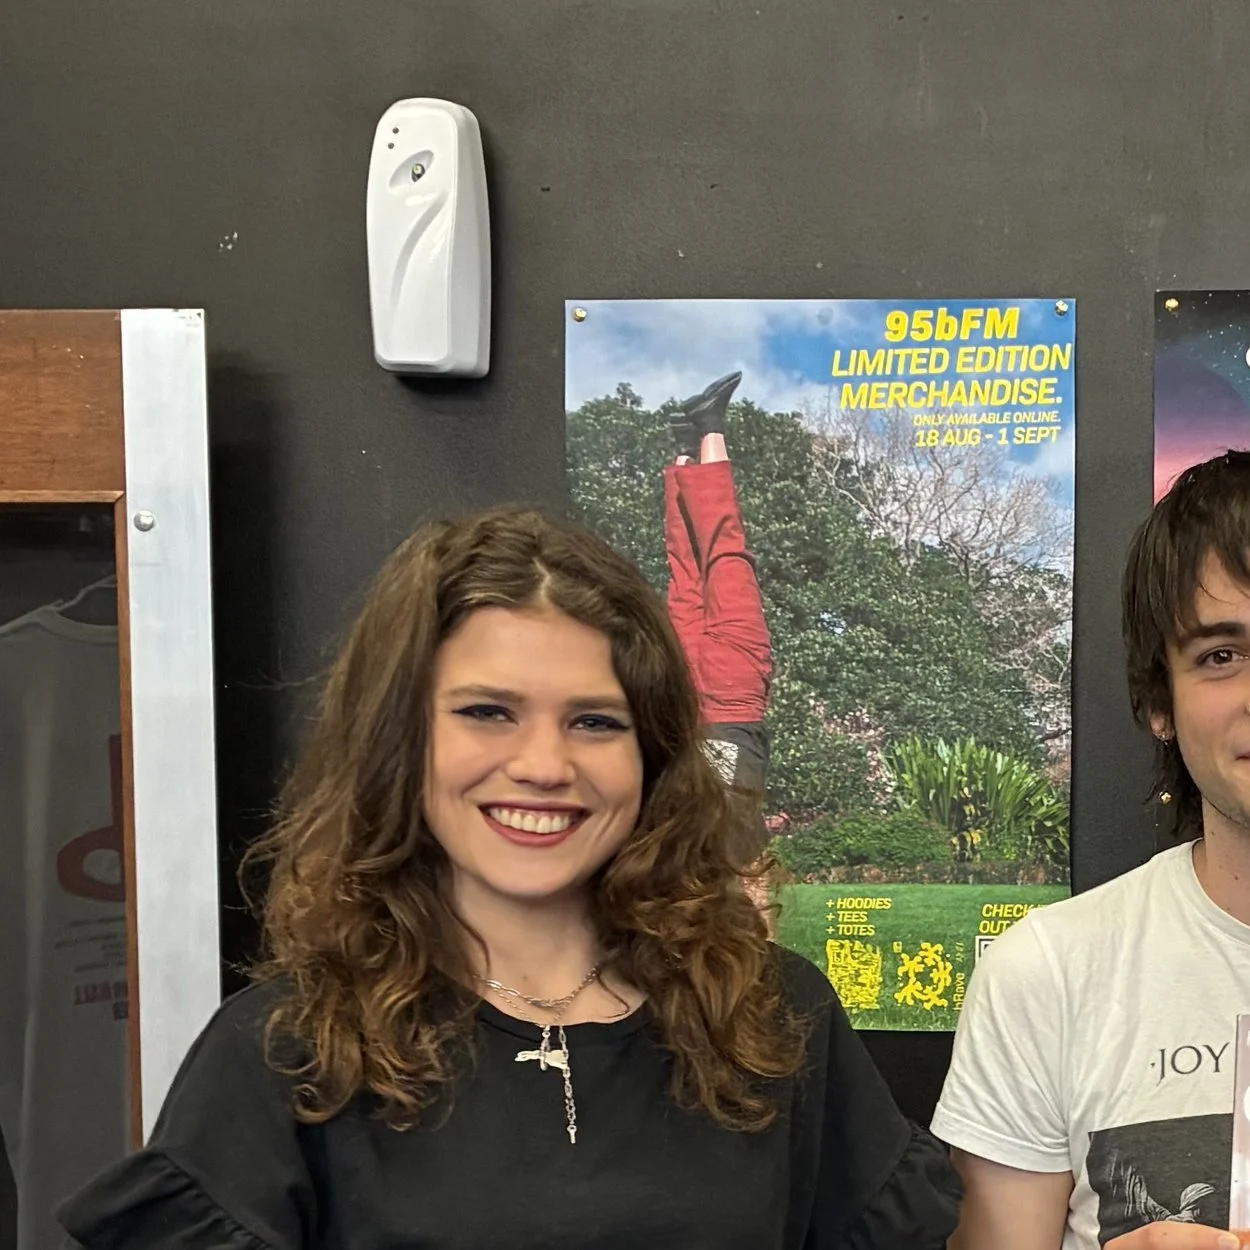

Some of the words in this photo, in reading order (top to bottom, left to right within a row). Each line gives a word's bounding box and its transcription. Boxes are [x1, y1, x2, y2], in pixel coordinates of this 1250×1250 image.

[884, 307, 1020, 342] 95bFM
[832, 347, 949, 376] LIMITED
[955, 343, 1072, 374] EDITION
[839, 378, 1062, 410] MERCHANDISE.
[913, 414, 944, 426] ONLY
[945, 412, 1011, 425] AVAILABLE
[1012, 411, 1061, 423] ONLINE.
[915, 429, 939, 448] 18
[942, 427, 981, 446] AUG
[997, 428, 1008, 445] 1
[1013, 426, 1061, 445] SEPT
[837, 897, 892, 910] HOODIES
[837, 911, 867, 923] TEES
[837, 924, 876, 936] TOTES
